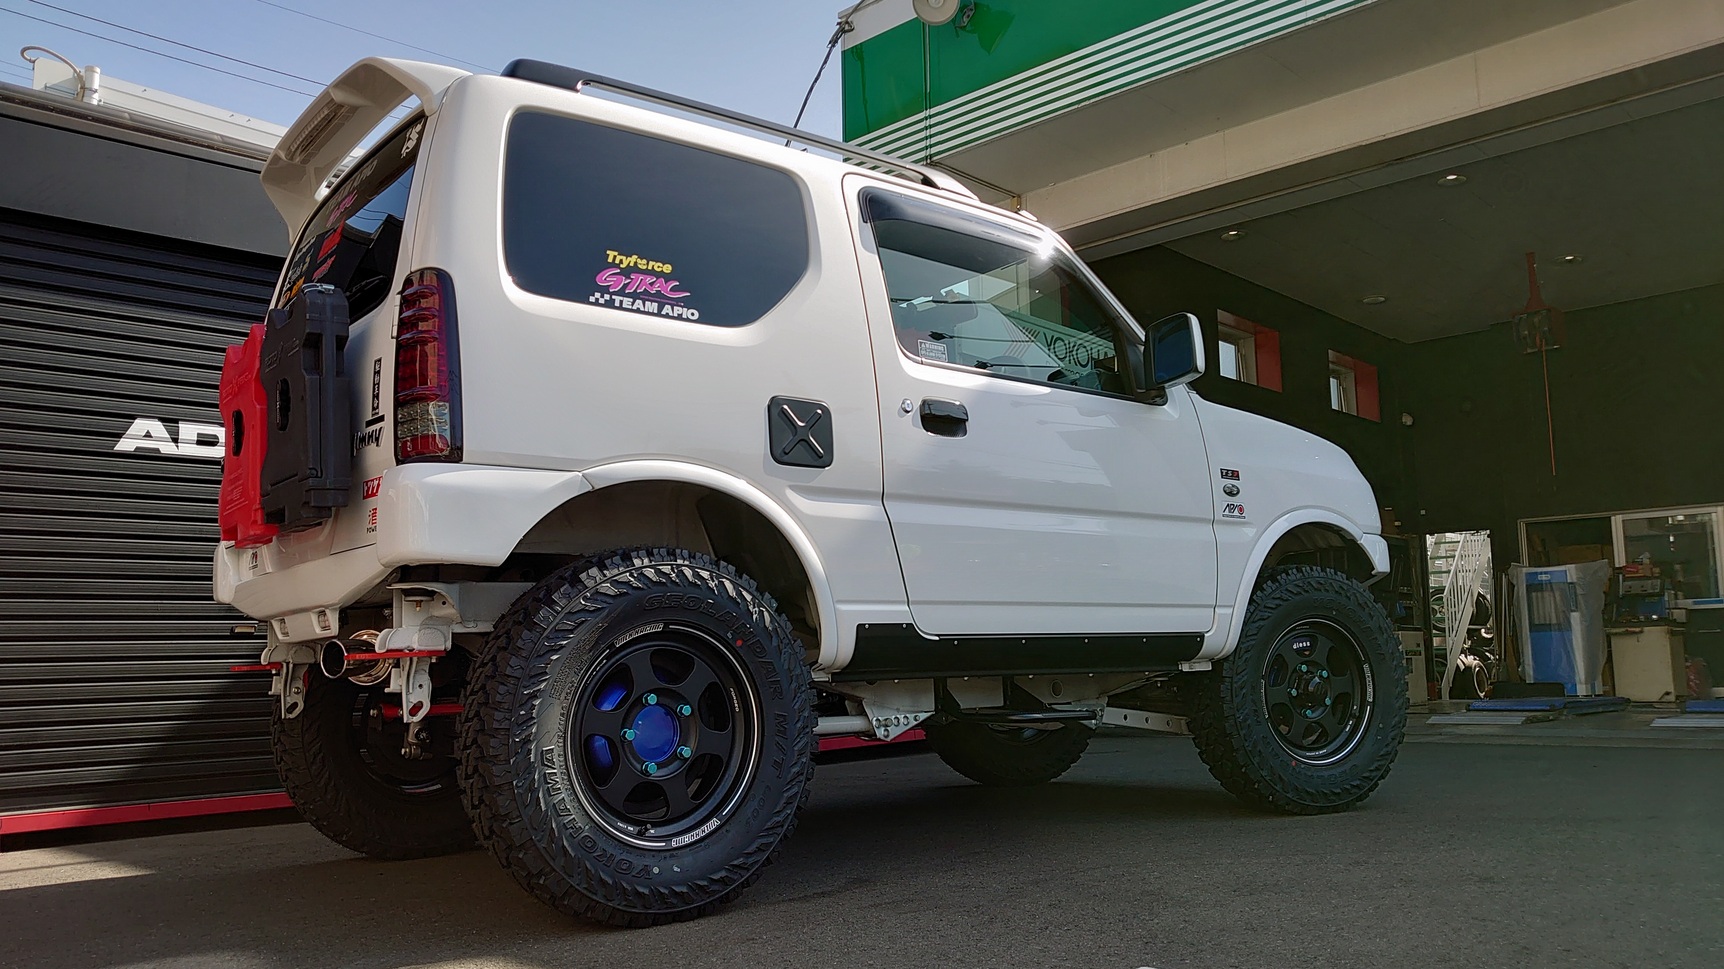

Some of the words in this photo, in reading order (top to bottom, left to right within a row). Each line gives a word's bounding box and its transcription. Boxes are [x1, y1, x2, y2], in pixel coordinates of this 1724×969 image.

[606, 249, 672, 274] Tryforce
[612, 294, 658, 314] TEAM
[661, 304, 699, 321] APIO
[113, 417, 226, 459] AD
[643, 592, 784, 700] GEOLANDAR
[771, 711, 789, 780] M/T
[542, 745, 654, 881] YOKOHAMA
